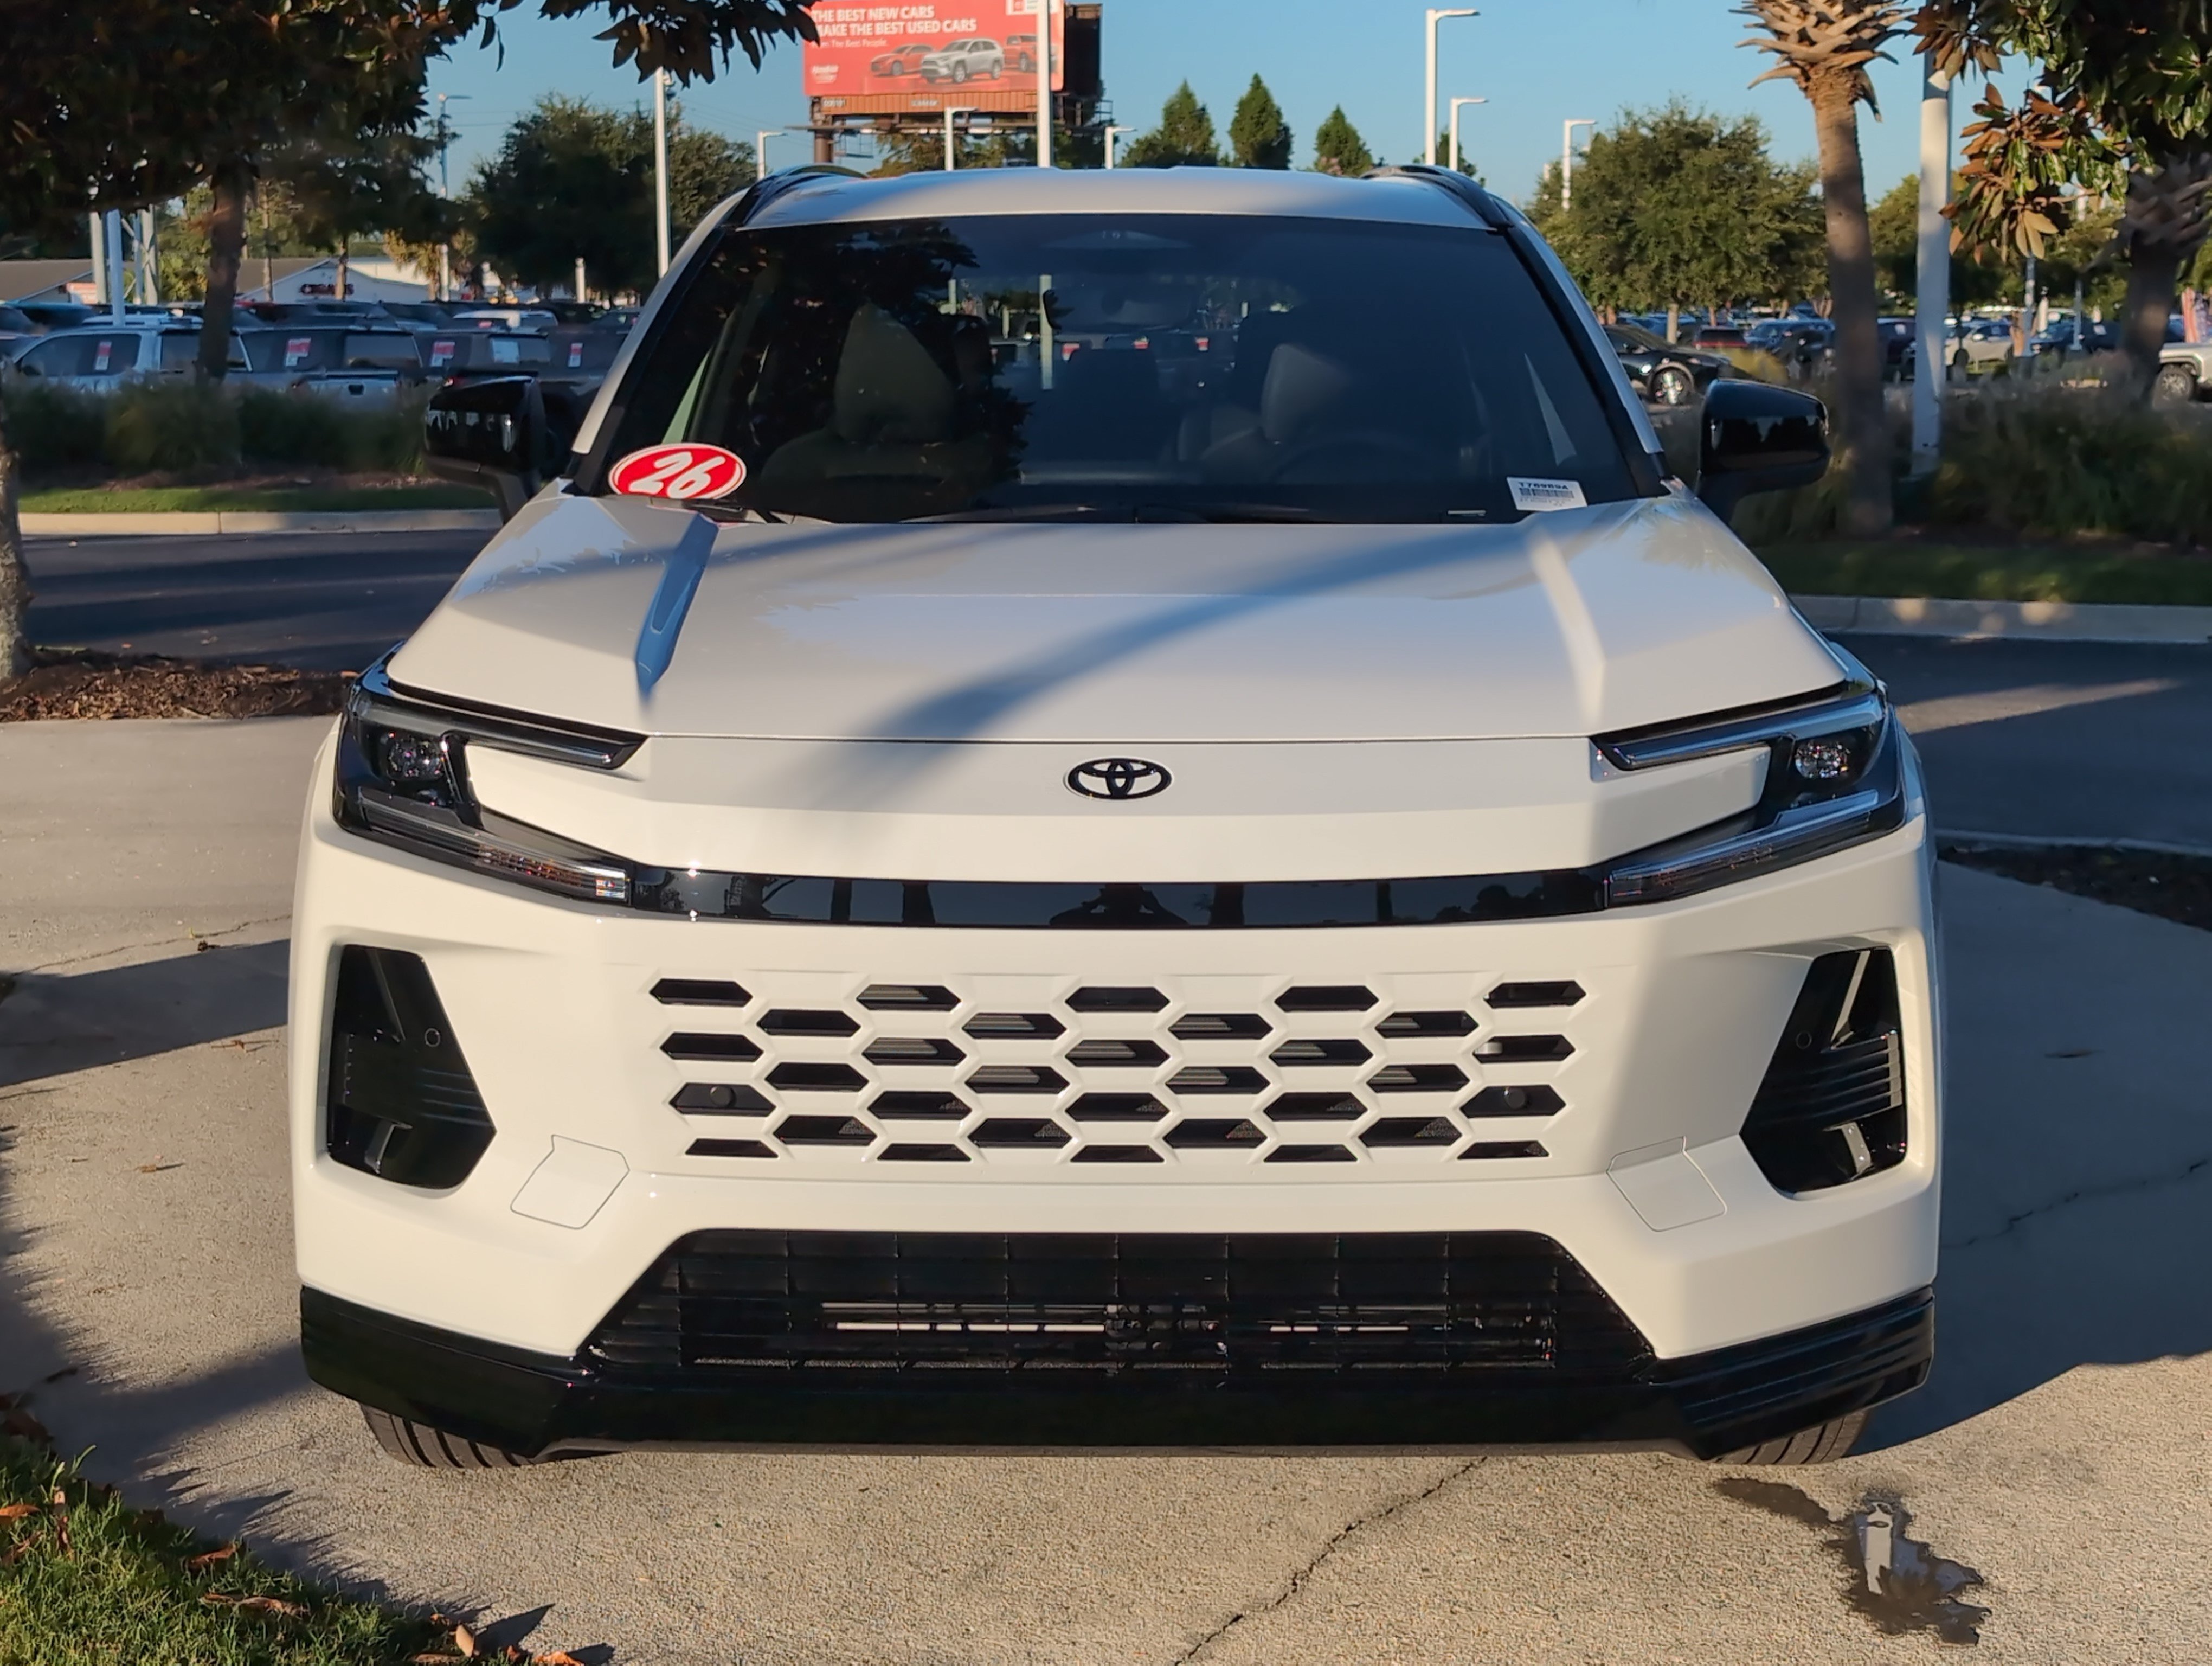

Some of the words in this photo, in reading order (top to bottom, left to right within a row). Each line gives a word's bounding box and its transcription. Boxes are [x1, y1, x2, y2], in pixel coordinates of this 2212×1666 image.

[813, 9, 835, 22] THE
[837, 8, 866, 21] BEST
[868, 7, 900, 20] NEW
[900, 5, 935, 19] CARS
[849, 22, 873, 36] THE
[875, 21, 905, 35] BEST
[906, 20, 941, 34] USED
[942, 18, 976, 33] CARS
[628, 451, 726, 499] 26
